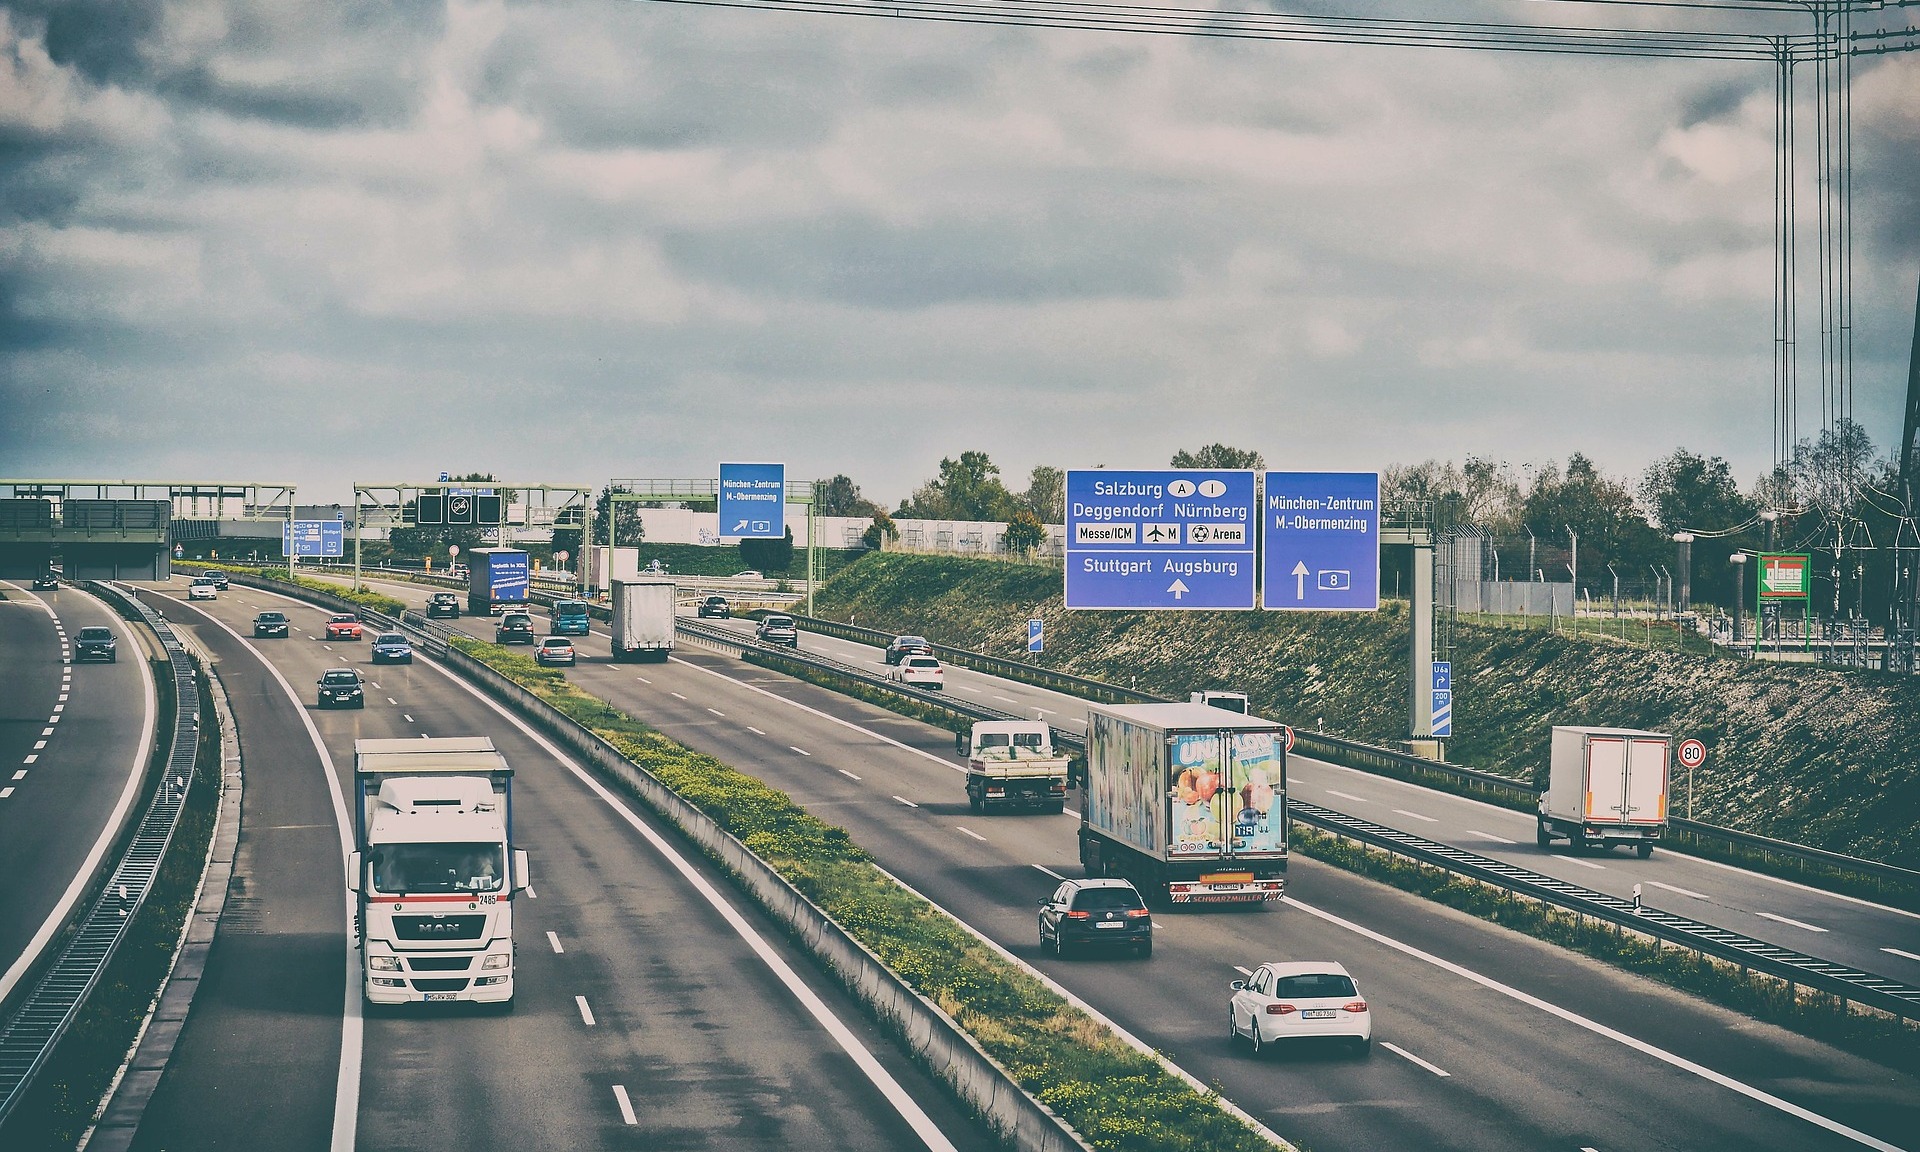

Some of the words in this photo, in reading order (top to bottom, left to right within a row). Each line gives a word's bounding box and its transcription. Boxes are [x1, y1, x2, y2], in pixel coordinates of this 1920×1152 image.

[723, 479, 780, 489] München-Zentrum
[1094, 481, 1163, 499] Salzburg
[1177, 483, 1187, 494] A
[726, 492, 777, 502] M.-Obermenzing
[1269, 495, 1374, 511] München-Zentrum
[1073, 502, 1164, 521] Deggendorf
[1174, 503, 1247, 521] Nürnberg
[1275, 515, 1367, 533] M.-Obermenzing
[1080, 527, 1132, 539] Messe/ICM
[1168, 528, 1177, 539] M
[1212, 528, 1241, 539] Arena
[1083, 557, 1152, 576] Stuttgart
[1163, 558, 1238, 577] Augsburg
[1330, 574, 1338, 586] 8
[1684, 747, 1700, 760] 80
[1236, 826, 1254, 836] TIR
[479, 895, 496, 905] 2485
[419, 924, 459, 932] MAN
